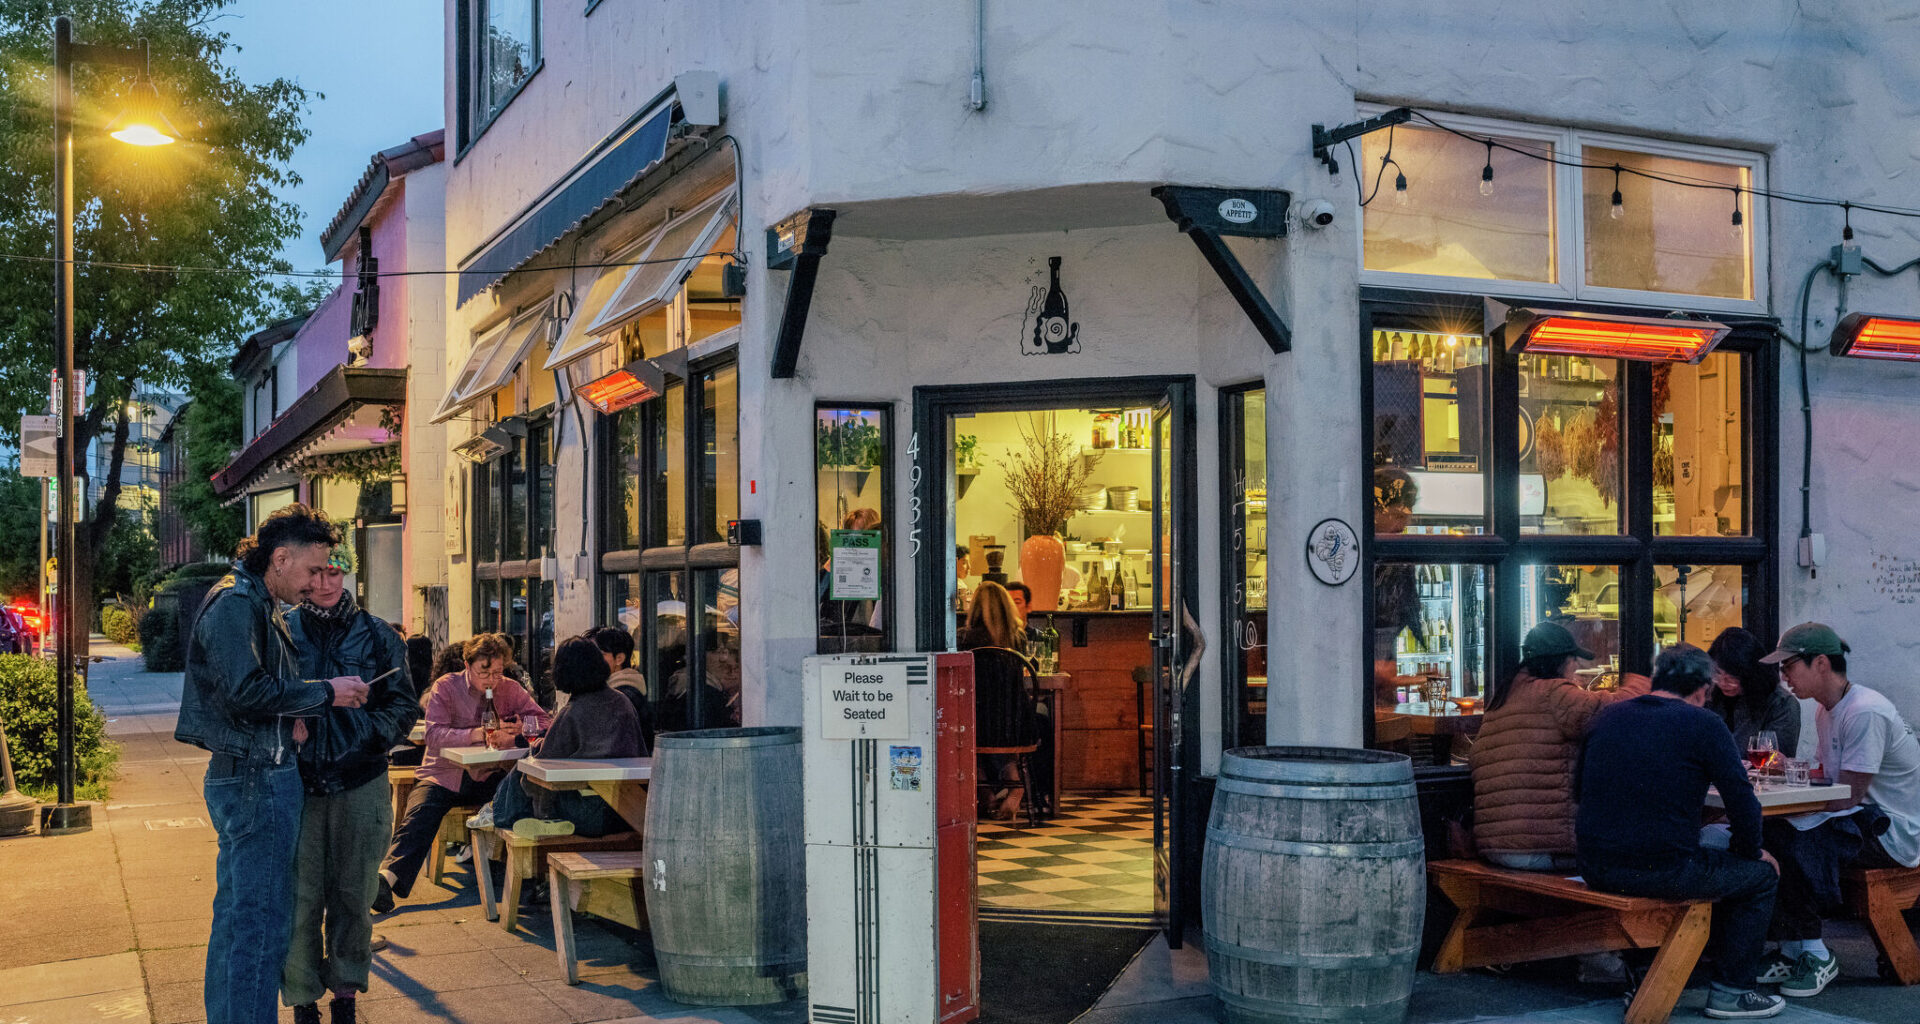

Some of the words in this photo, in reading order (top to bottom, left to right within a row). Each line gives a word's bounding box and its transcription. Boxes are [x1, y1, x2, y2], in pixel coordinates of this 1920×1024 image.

[1232, 201, 1245, 209] BON
[906, 432, 922, 558] 4935
[842, 537, 869, 548] PASS
[1233, 527, 1243, 551] 5
[1233, 582, 1242, 604] 5
[844, 672, 883, 684] Please
[833, 690, 860, 702] Wait
[862, 691, 875, 702] to
[878, 690, 893, 702] be
[843, 707, 886, 720] Seated
